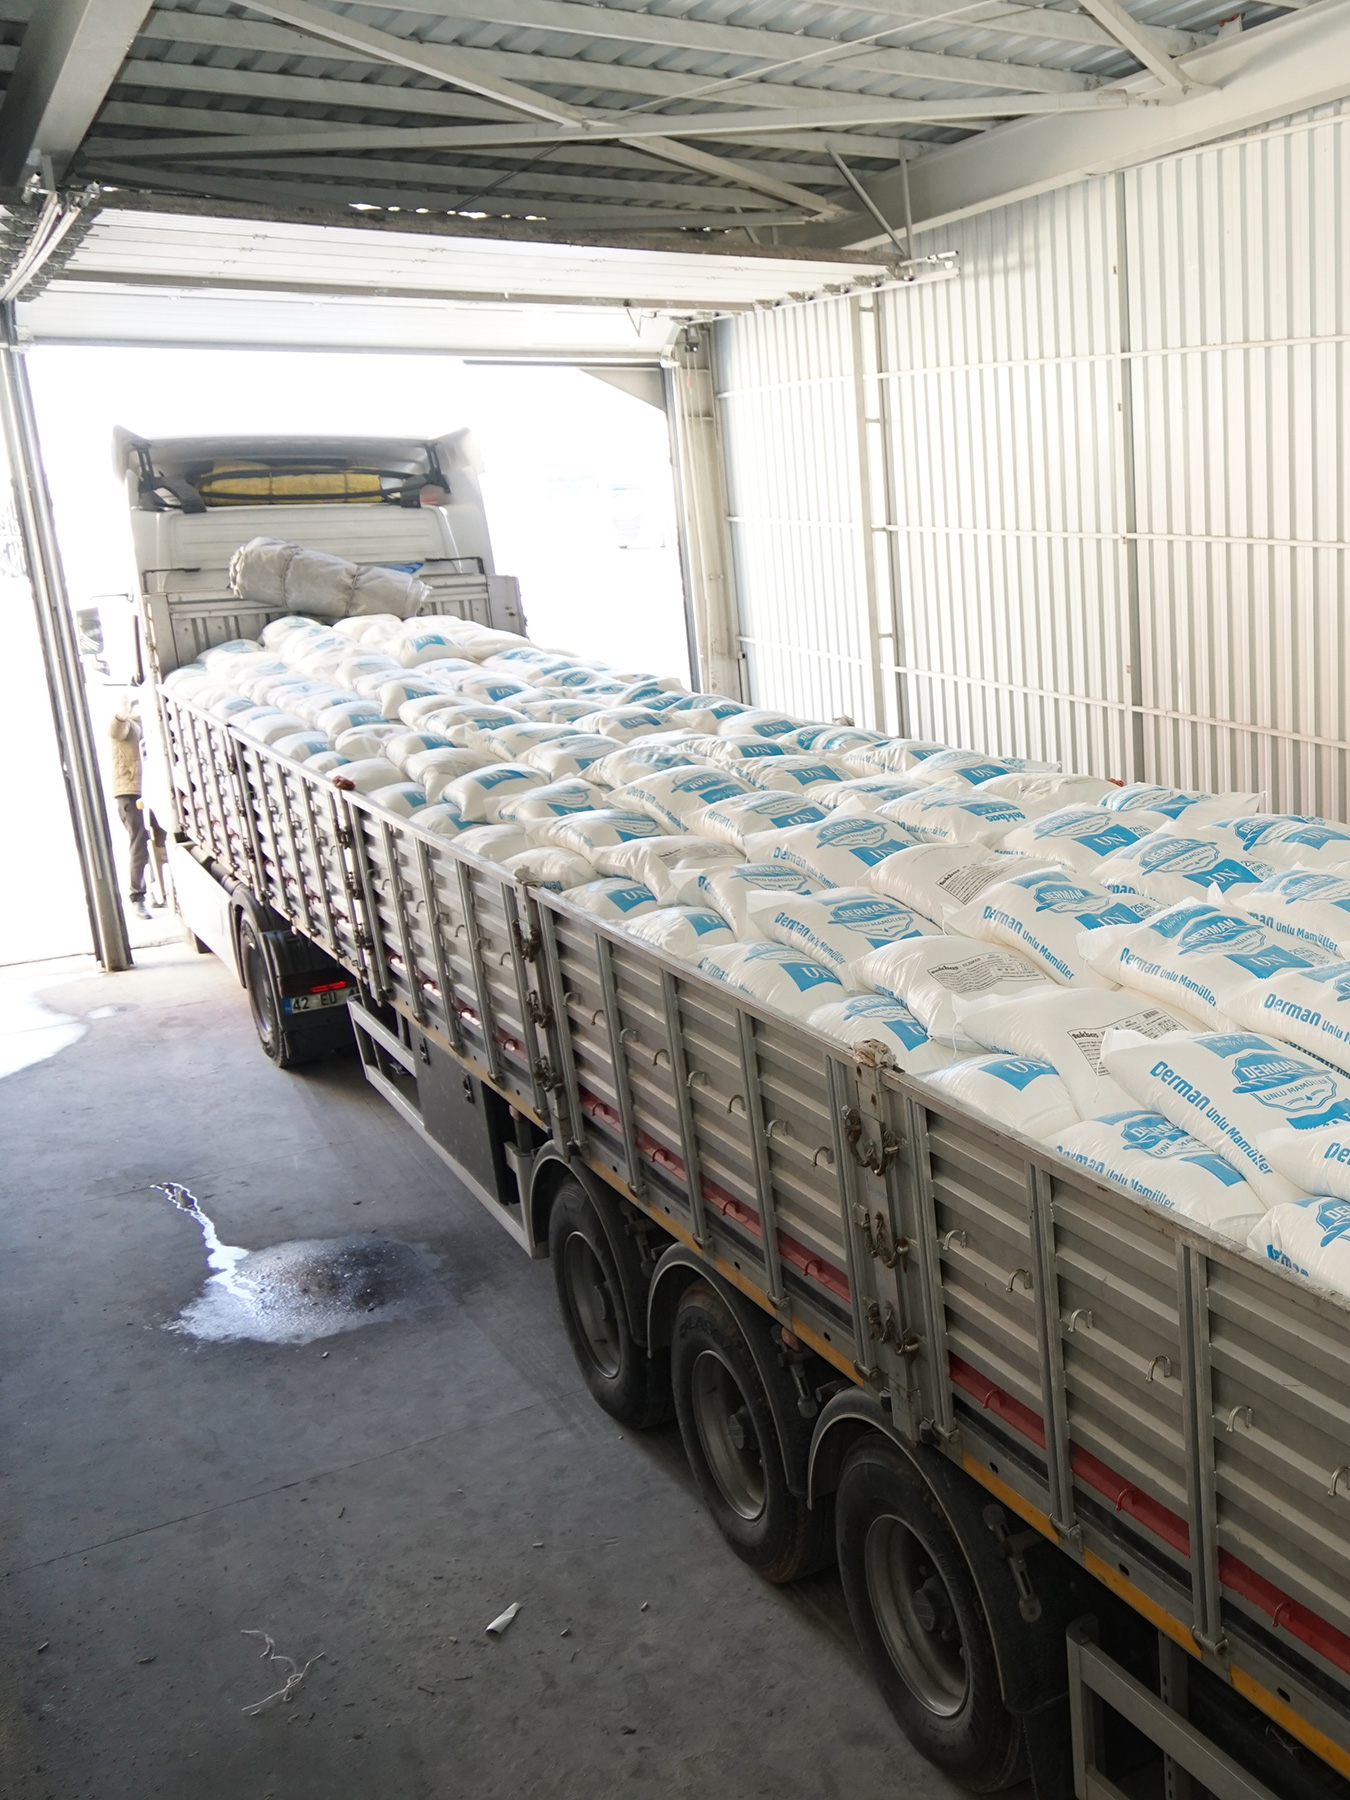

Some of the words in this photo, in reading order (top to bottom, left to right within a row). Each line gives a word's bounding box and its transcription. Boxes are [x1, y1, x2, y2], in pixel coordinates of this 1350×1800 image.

[801, 768, 826, 778] UN
[970, 767, 998, 778] UN
[1092, 833, 1127, 846] UN
[1144, 839, 1193, 863] DERMAN
[1205, 868, 1241, 884] UN
[1039, 888, 1086, 902] DERMAN
[840, 903, 889, 918] DERMAN
[1186, 918, 1239, 943] DERMAN
[1275, 921, 1296, 936] Unlu
[1296, 928, 1338, 951] Mamüller
[1022, 929, 1041, 951] Unlu
[1038, 944, 1076, 981] Mamüller
[1251, 953, 1289, 967] UN
[1160, 968, 1179, 983] Unlu
[1263, 993, 1323, 1027] Derman
[1321, 1019, 1344, 1040] Unlu
[1003, 1059, 1050, 1074] UN
[1239, 1059, 1303, 1079] DERMAN
[1262, 1088, 1288, 1102] UNLU
[1150, 1060, 1211, 1111] Derman
[1205, 1107, 1228, 1132] Unlu
[1226, 1127, 1274, 1176] Mamüller
